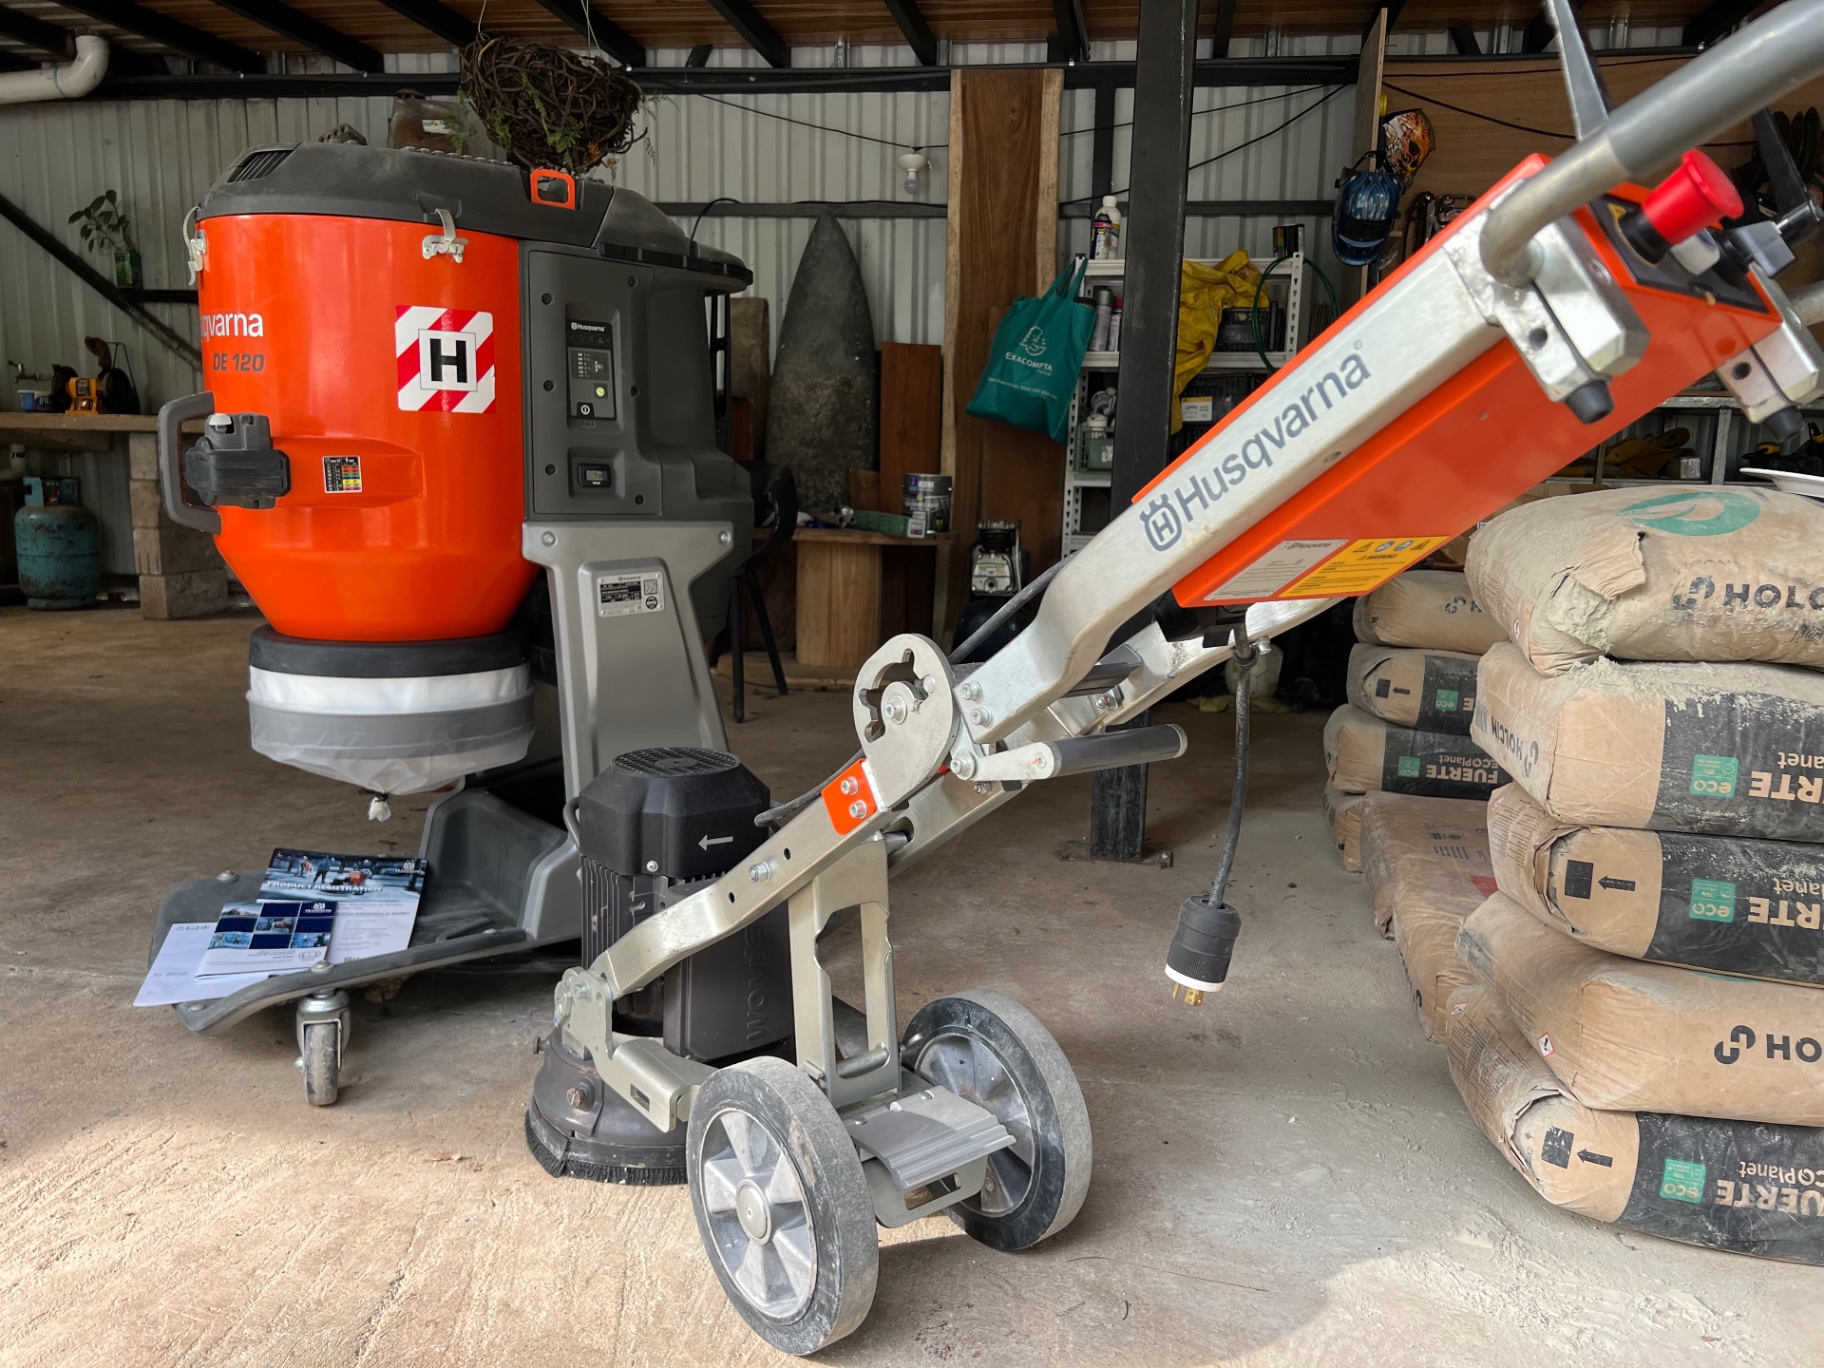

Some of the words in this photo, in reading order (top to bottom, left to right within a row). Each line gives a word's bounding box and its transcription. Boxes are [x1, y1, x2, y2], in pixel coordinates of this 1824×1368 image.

[201, 313, 264, 342] qvarna
[213, 353, 229, 371] DE
[232, 353, 265, 372] 120
[430, 338, 468, 383] H
[1005, 351, 1053, 372] EXACOMPTA
[1174, 351, 1372, 523] Husqvarna
[1426, 764, 1498, 784] FUERTE
[1693, 779, 1732, 794] eco
[1692, 903, 1731, 918] eco
[1663, 1183, 1700, 1199] eco
